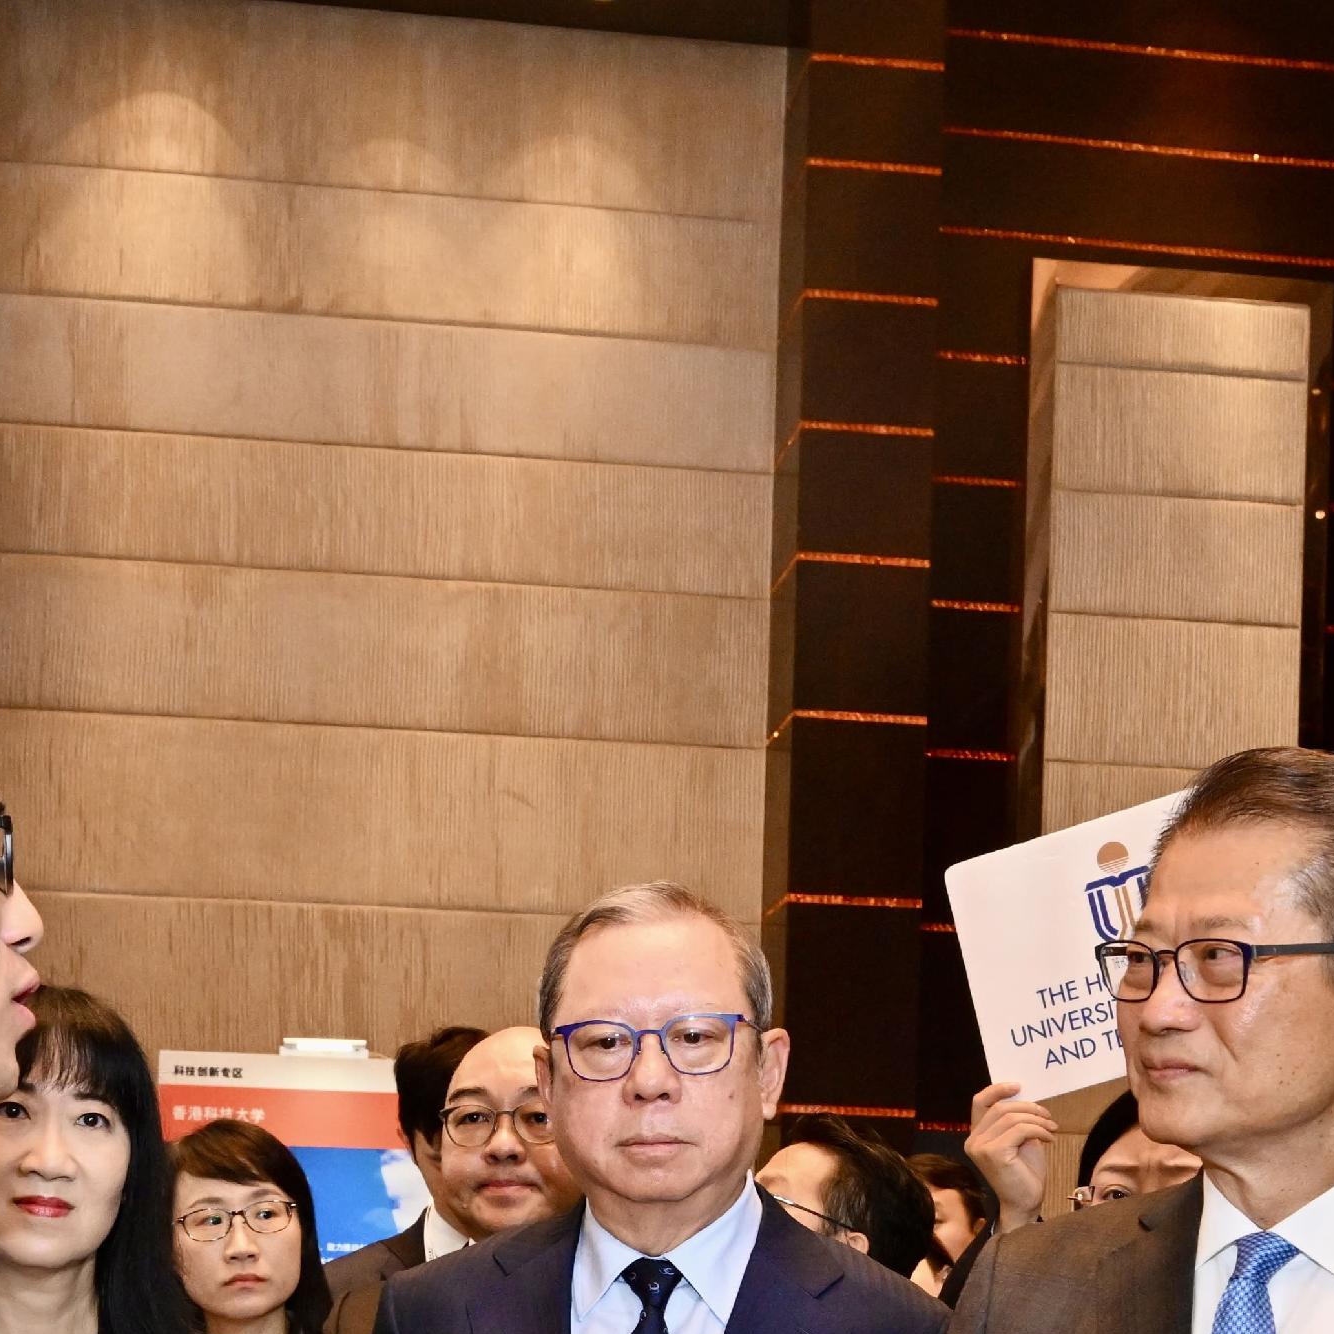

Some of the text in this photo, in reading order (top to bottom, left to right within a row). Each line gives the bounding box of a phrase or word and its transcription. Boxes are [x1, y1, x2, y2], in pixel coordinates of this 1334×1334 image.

[1036, 980, 1079, 1009] THE
[1010, 998, 1117, 1047] UNIVERSI
[1044, 1036, 1097, 1070] AND
